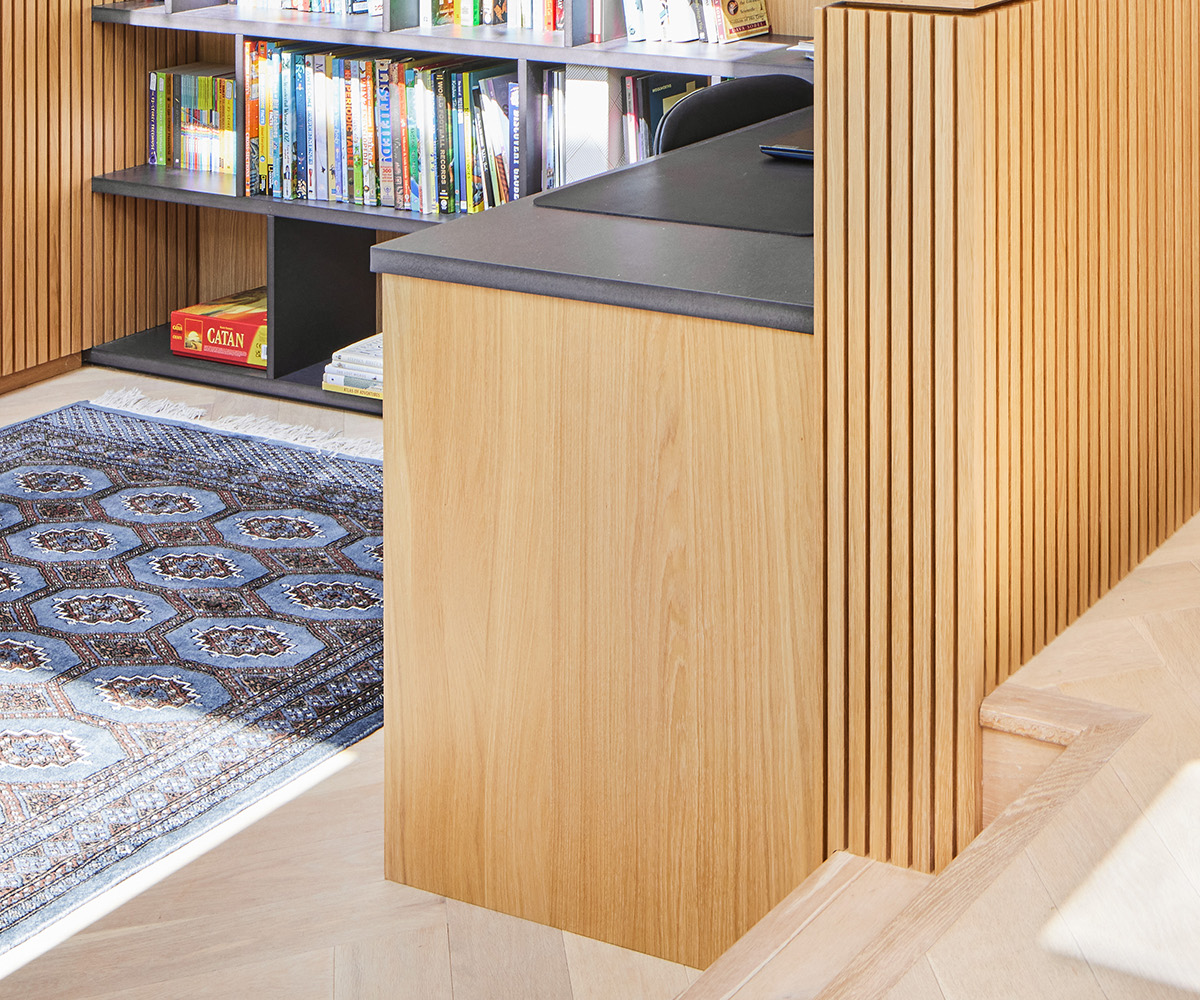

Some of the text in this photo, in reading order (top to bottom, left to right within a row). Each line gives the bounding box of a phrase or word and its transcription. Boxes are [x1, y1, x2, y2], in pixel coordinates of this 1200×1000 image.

[345, 84, 353, 133] PERIODIC
[378, 68, 392, 163] LISTIFIED!
[207, 328, 245, 349] CATAN
